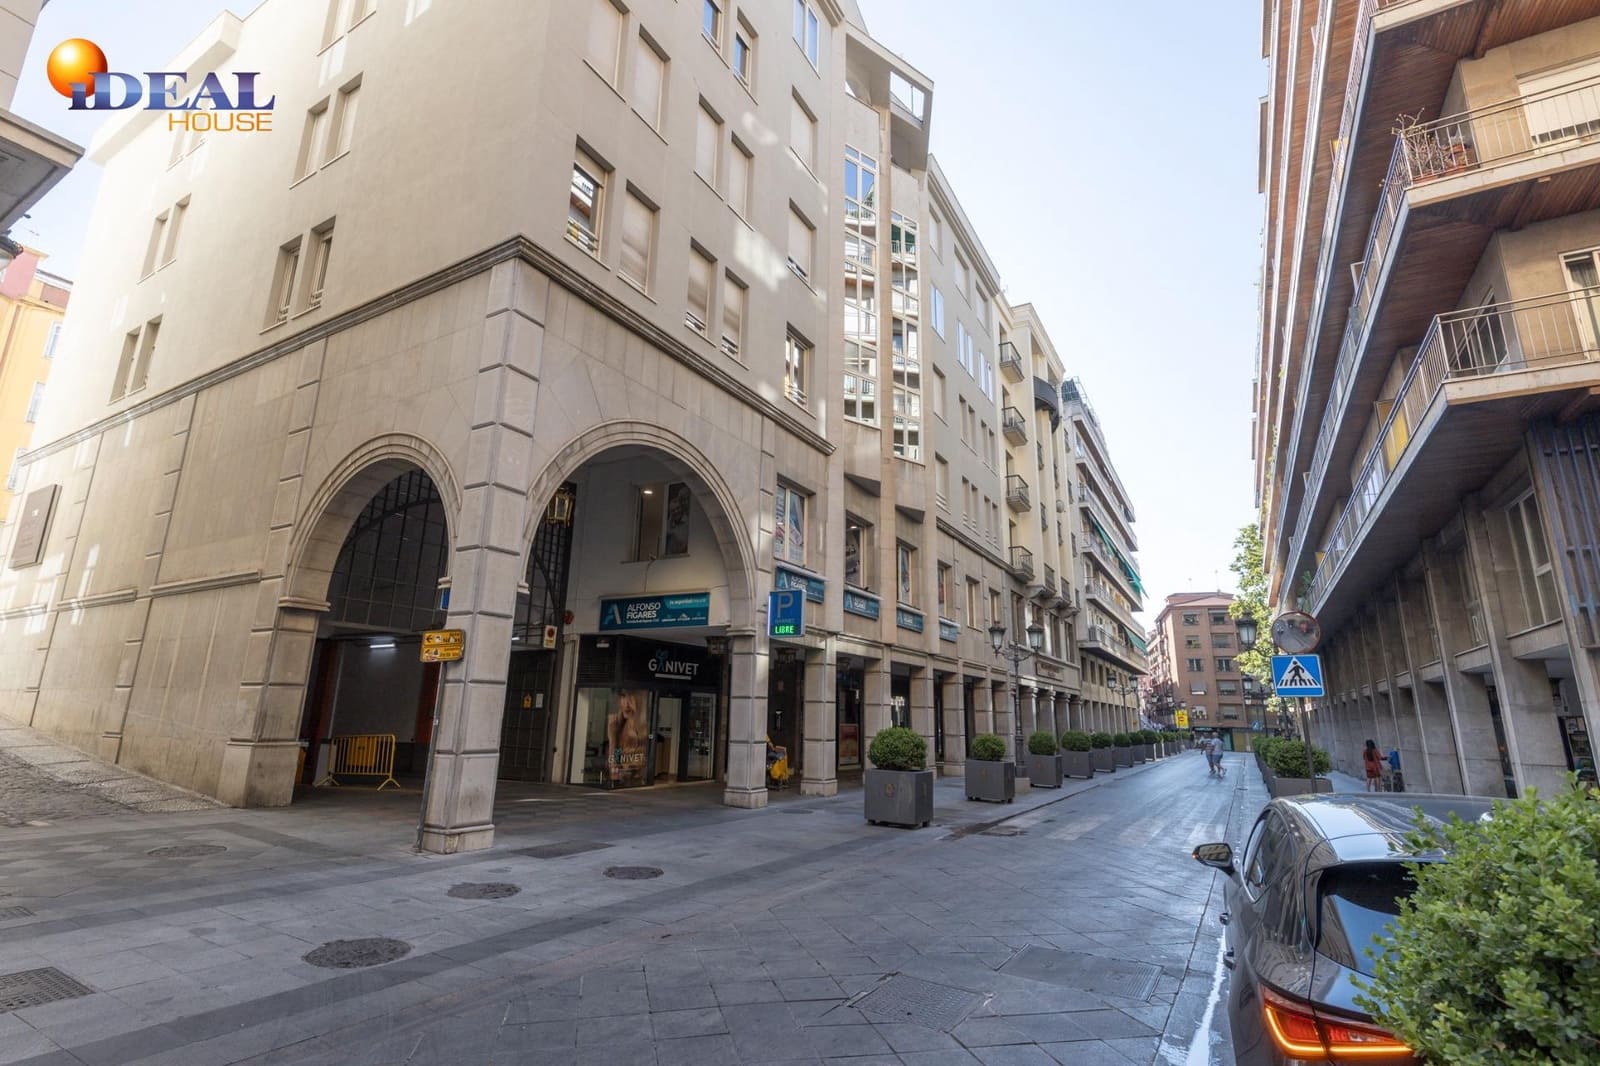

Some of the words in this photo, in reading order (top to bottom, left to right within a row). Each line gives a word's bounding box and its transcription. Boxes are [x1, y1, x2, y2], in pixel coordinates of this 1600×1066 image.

[627, 602, 661, 612] ALFONSO
[777, 592, 793, 618] P
[626, 610, 657, 619] FIGARES
[775, 625, 795, 634] LIBRE
